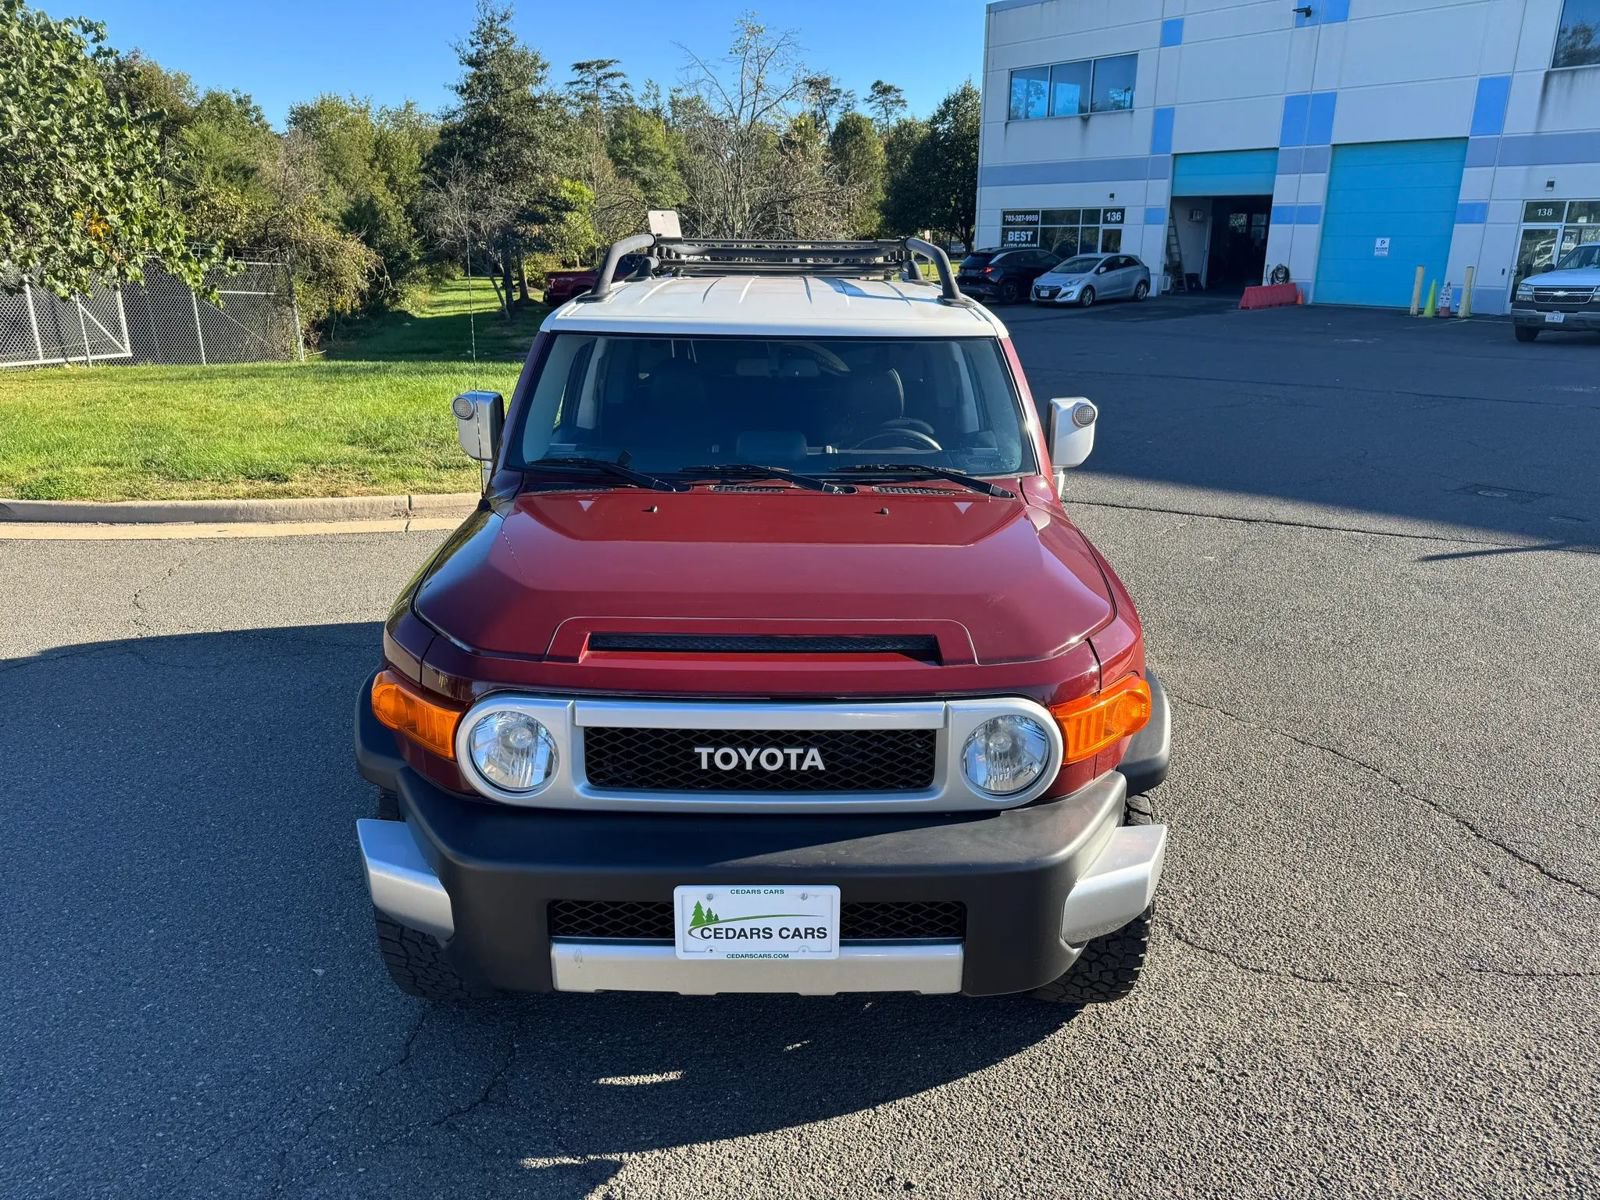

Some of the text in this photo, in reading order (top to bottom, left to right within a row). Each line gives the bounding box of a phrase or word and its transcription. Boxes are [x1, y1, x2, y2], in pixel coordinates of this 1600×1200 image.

[1106, 211, 1121, 221] 136
[1536, 208, 1553, 217] 138
[1008, 231, 1033, 242] BEST
[694, 747, 826, 771] TOYOTA
[700, 927, 828, 940] CEDARS CARS
